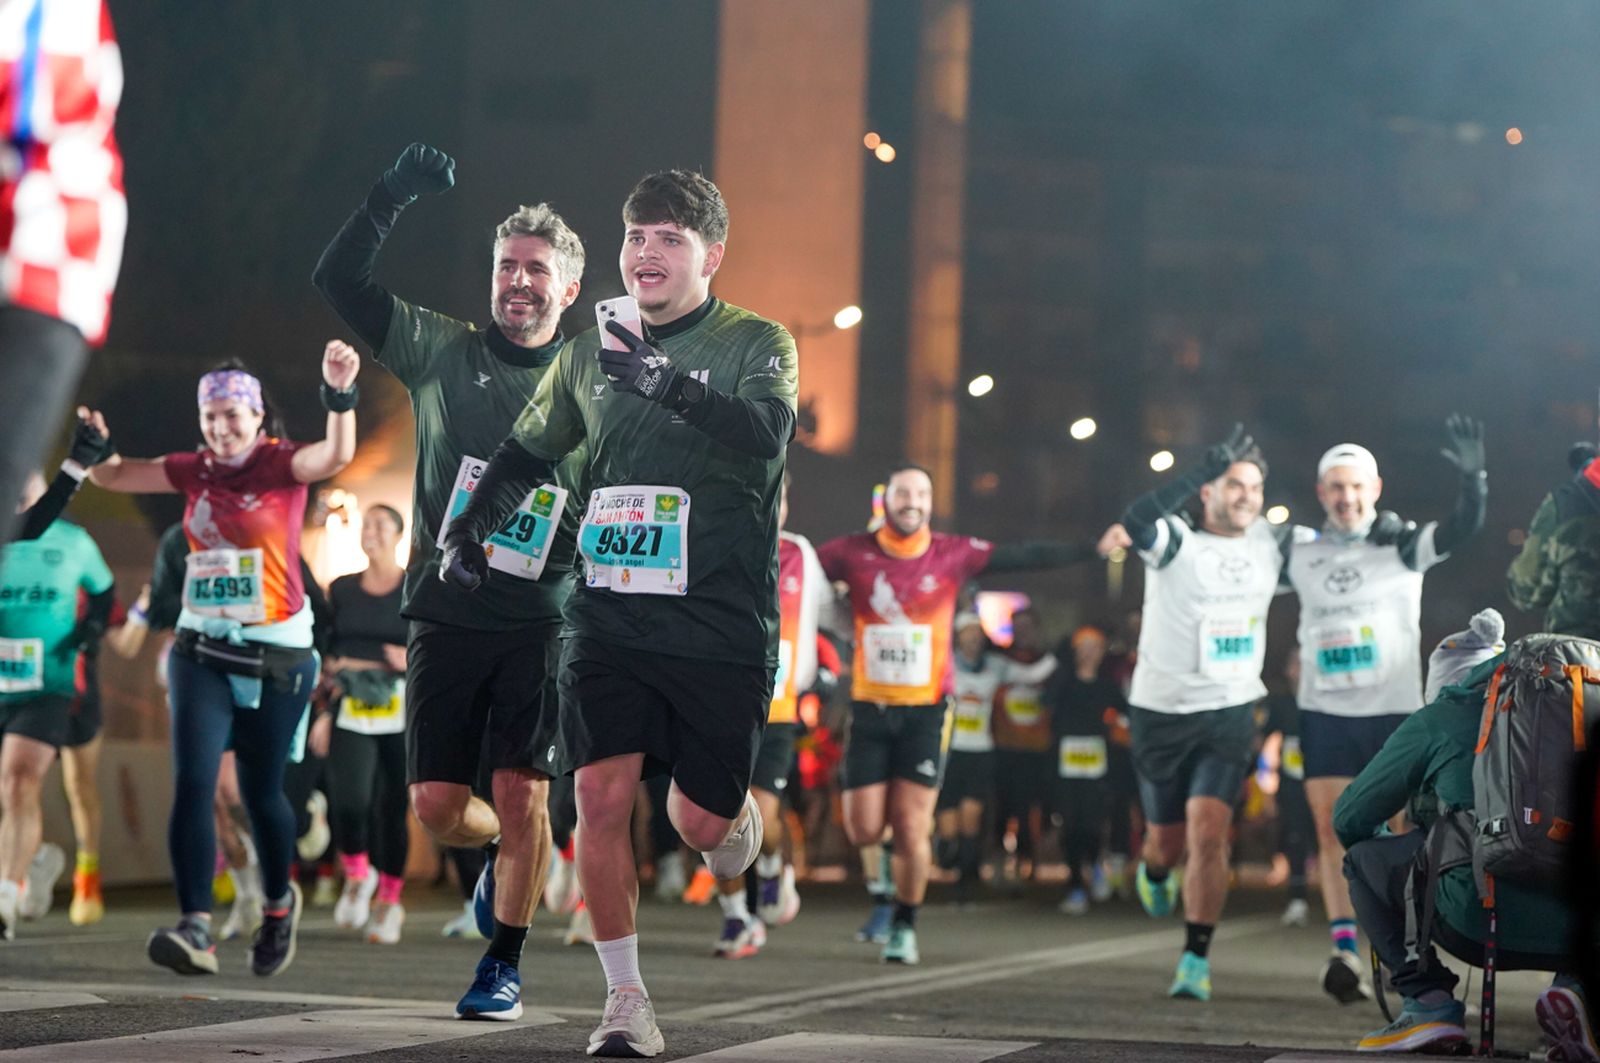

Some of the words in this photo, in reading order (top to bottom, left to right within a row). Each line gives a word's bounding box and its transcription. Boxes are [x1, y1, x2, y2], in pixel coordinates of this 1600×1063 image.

[606, 497, 632, 510] NOCHE
[632, 497, 645, 508] DE
[595, 525, 663, 556] 9327
